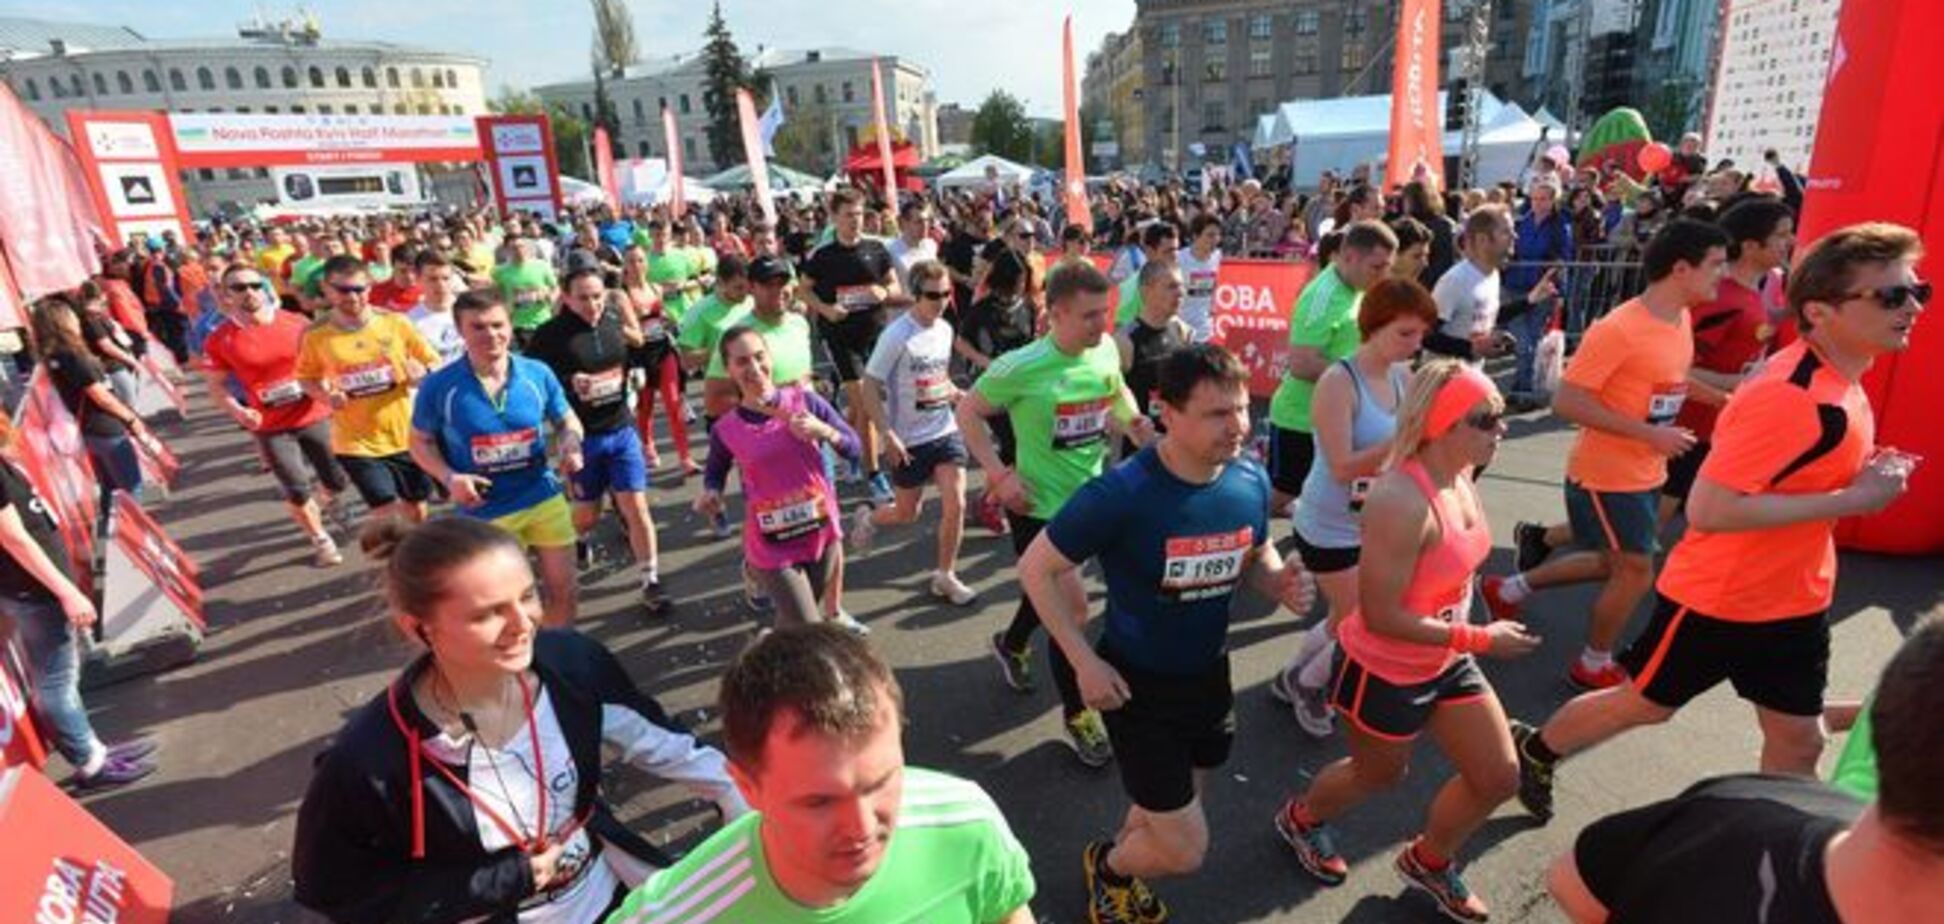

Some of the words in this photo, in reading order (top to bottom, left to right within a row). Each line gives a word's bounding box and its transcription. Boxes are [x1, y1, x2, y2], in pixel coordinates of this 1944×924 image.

[212, 127, 258, 141] Nova
[261, 127, 314, 140] Poshta
[1214, 284, 1277, 313] ОВА
[1195, 556, 1235, 577] 1989
